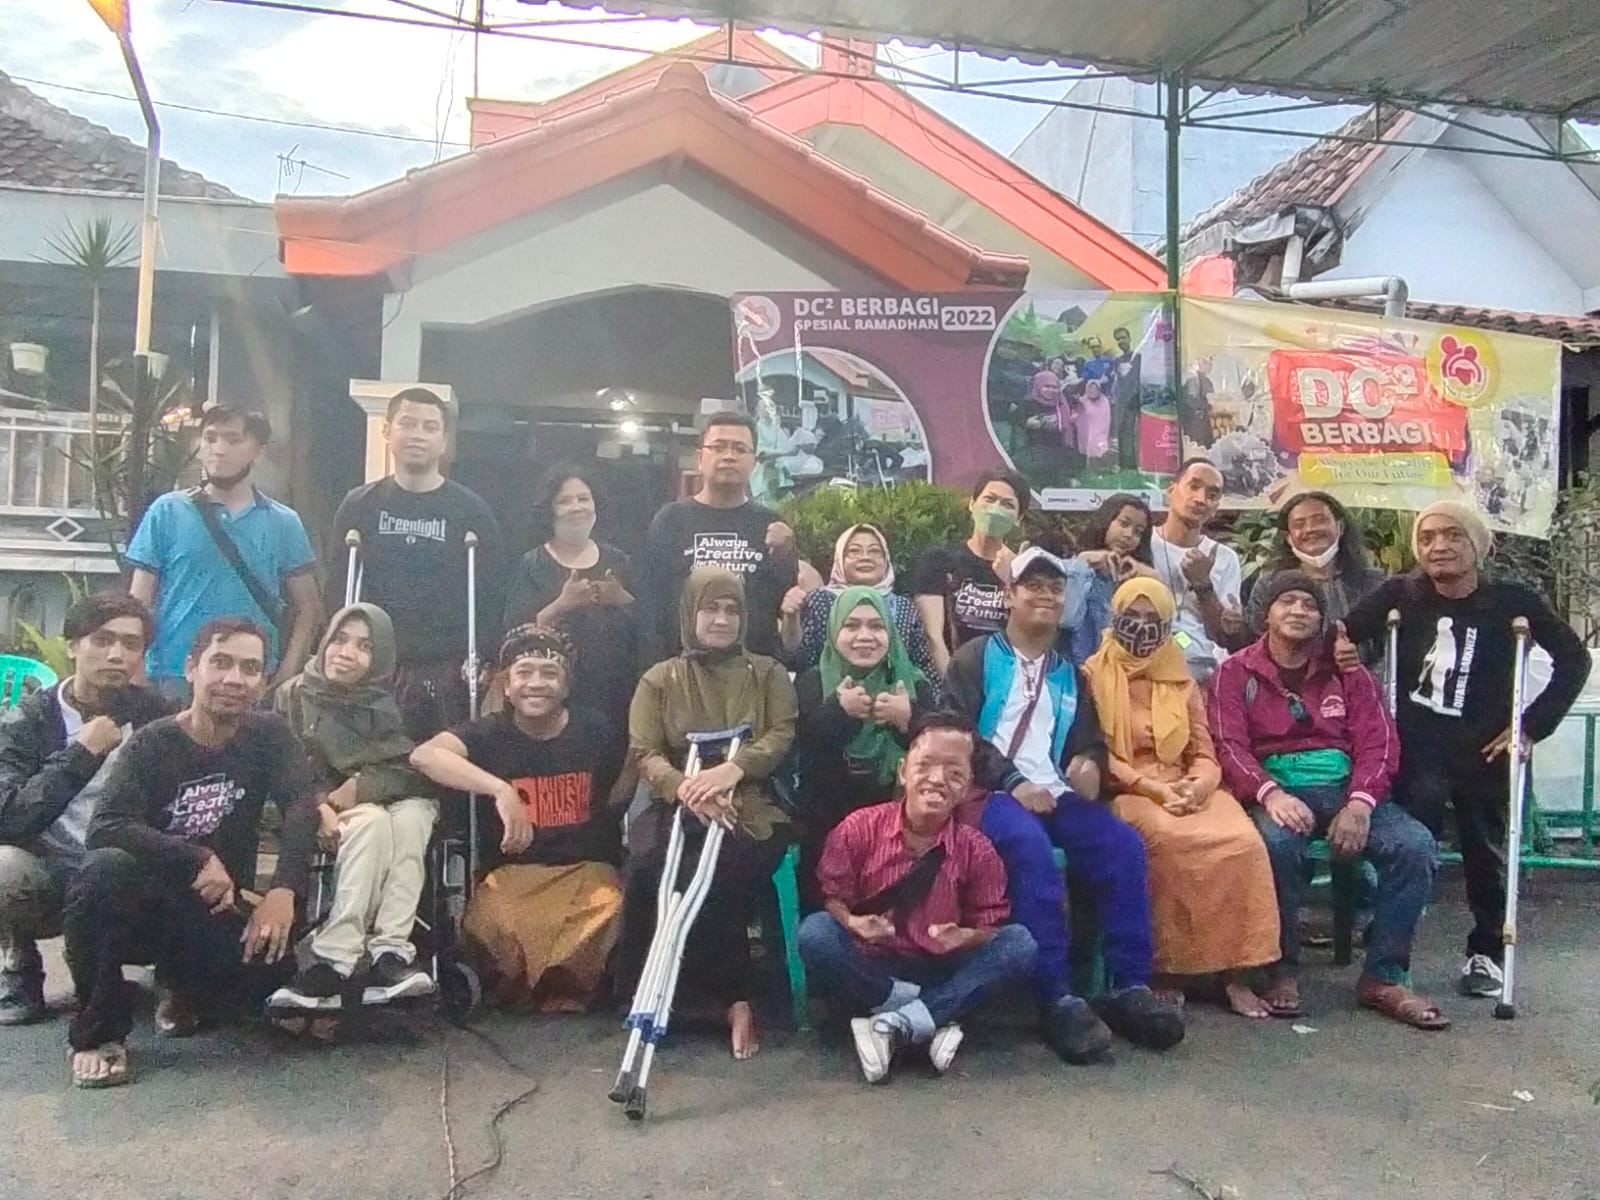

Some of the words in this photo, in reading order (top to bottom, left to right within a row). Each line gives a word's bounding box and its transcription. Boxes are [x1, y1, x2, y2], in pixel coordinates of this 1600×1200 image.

[841, 297, 939, 316] BERBAGI
[795, 318, 851, 331] SPESIAL
[855, 318, 939, 331] RAMADHAN
[944, 309, 993, 326] 2022
[1300, 421, 1433, 445] BERBAGI
[699, 537, 749, 550] Always
[694, 547, 763, 562] Creative
